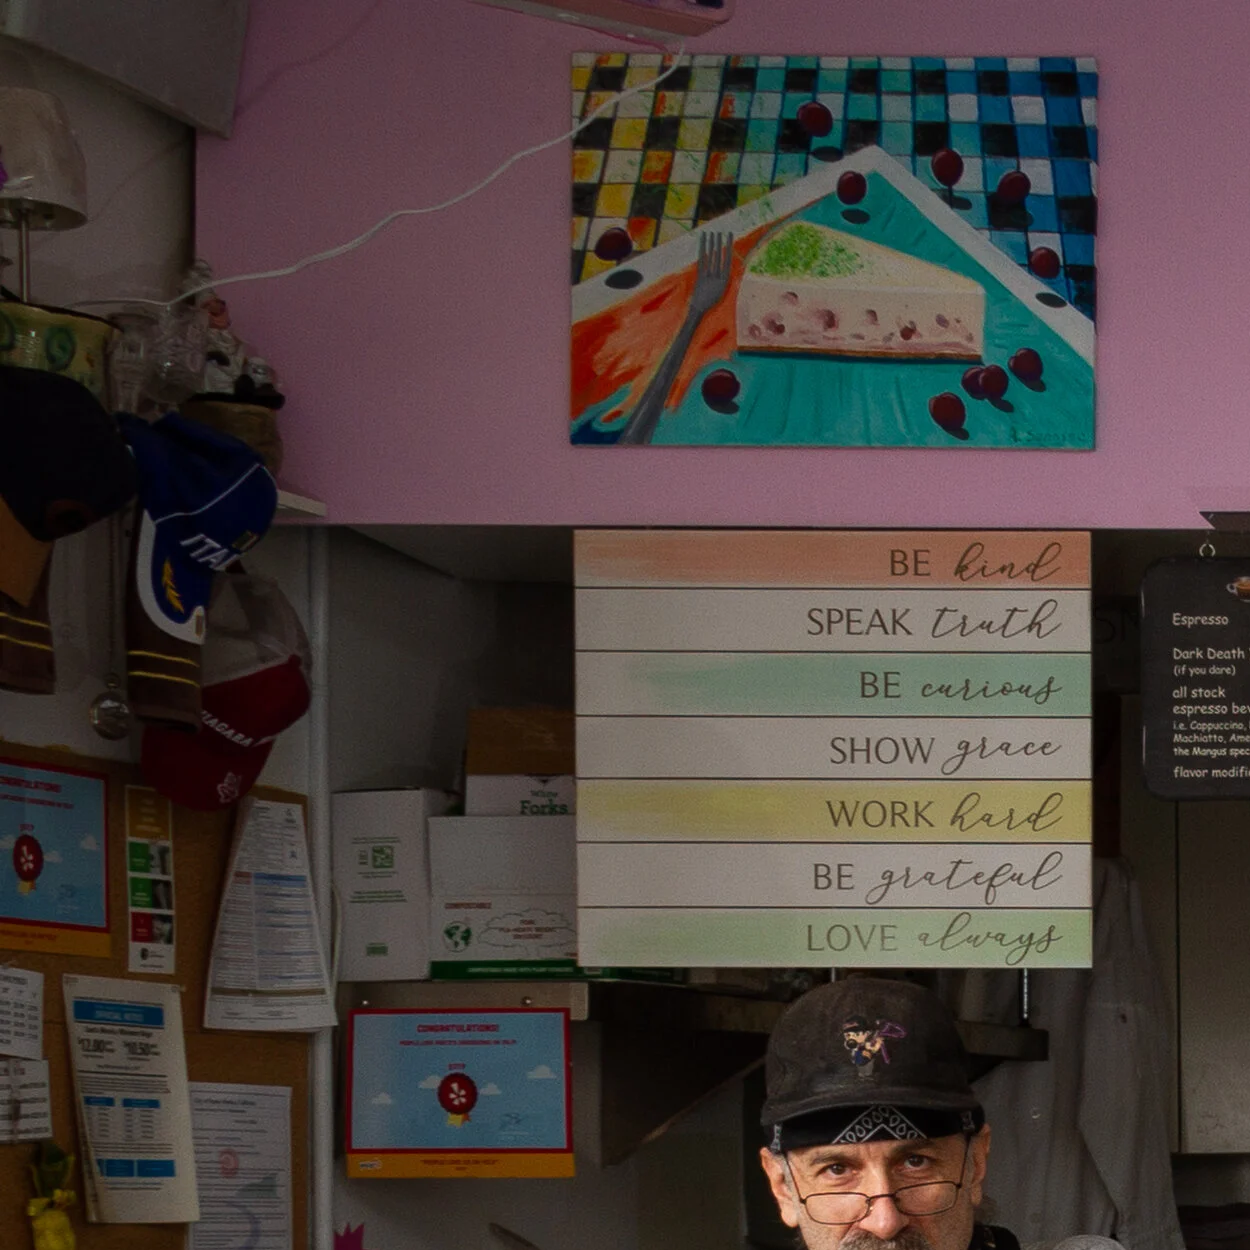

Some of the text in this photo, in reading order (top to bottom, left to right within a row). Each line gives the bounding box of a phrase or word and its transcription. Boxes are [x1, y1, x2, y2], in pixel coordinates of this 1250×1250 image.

[889, 542, 1062, 582] BE kind
[807, 599, 1062, 639] SPEAK truth
[1172, 613, 1229, 627] Espresso
[1173, 648, 1203, 660] Dark
[1207, 648, 1245, 660] Death
[860, 671, 1062, 705] BE curious
[1172, 687, 1225, 698] all stock
[1173, 705, 1228, 716] espresso
[829, 737, 1062, 776] SHOW grace
[1173, 766, 1208, 778] flavor
[825, 792, 1063, 832] WORK hard
[813, 851, 1063, 905] BE grateful
[806, 912, 1062, 966] LOVE always
